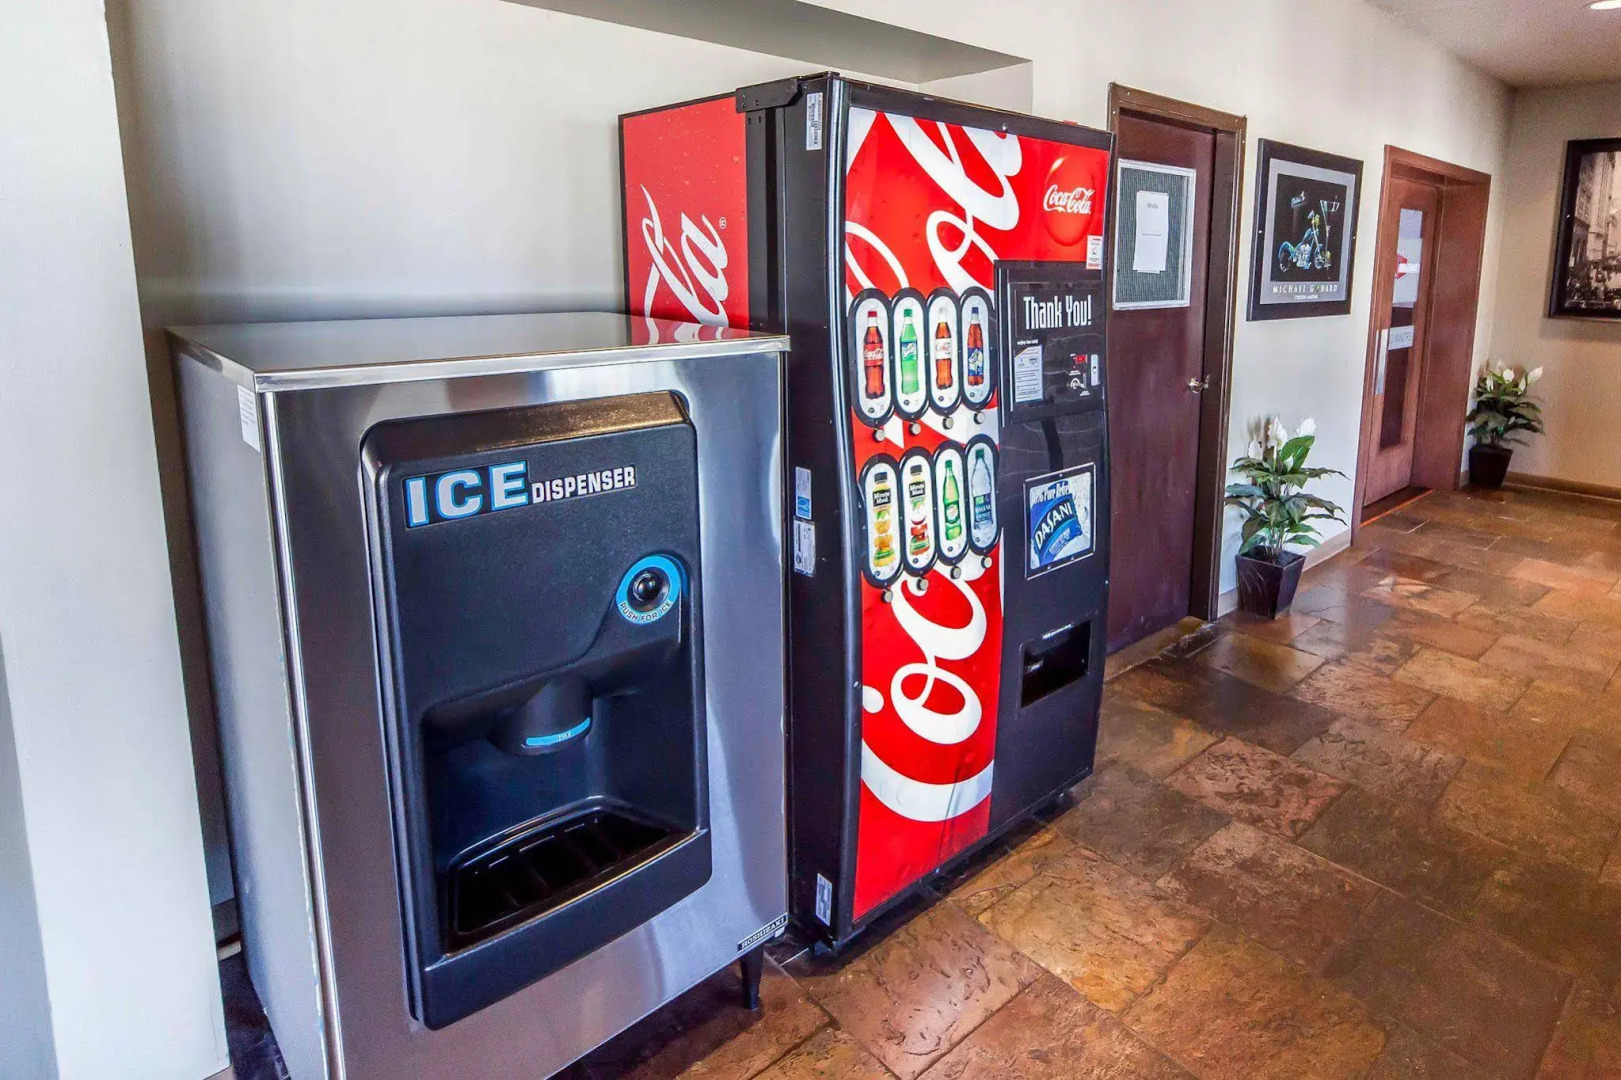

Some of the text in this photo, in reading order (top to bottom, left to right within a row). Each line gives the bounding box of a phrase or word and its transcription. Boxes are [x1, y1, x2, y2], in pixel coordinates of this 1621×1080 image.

[1273, 284, 1306, 294] MICHAEL
[1023, 294, 1092, 330] Thank You!
[405, 460, 636, 528] ICE DISPENSER
[1035, 502, 1073, 550] DASANI
[620, 600, 672, 621] PUSH FOR ICE
